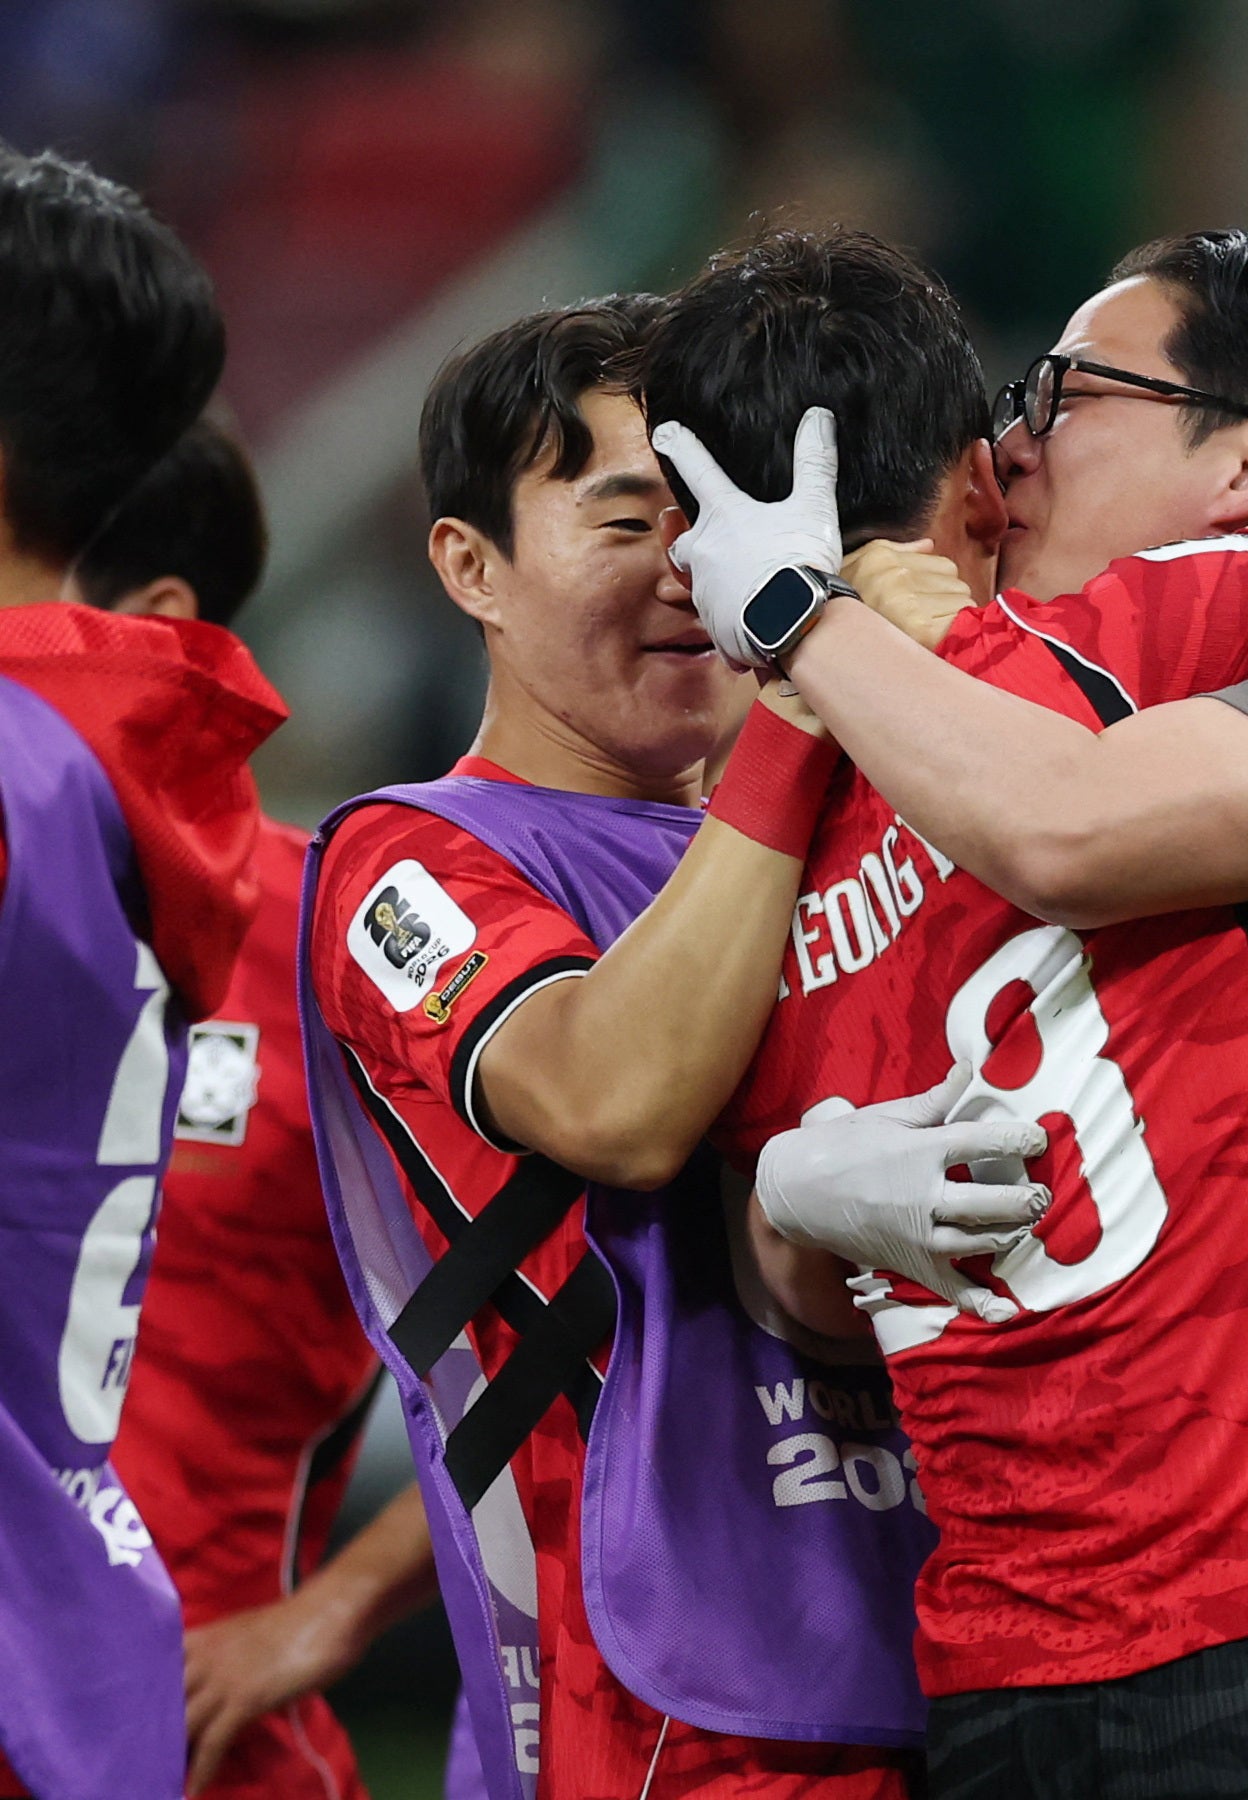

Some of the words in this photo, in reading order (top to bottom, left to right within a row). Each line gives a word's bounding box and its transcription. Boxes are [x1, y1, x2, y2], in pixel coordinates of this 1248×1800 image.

[401, 936, 423, 958] FIFA
[441, 955, 478, 1001] DEBUT
[754, 1377, 902, 1432] WORL
